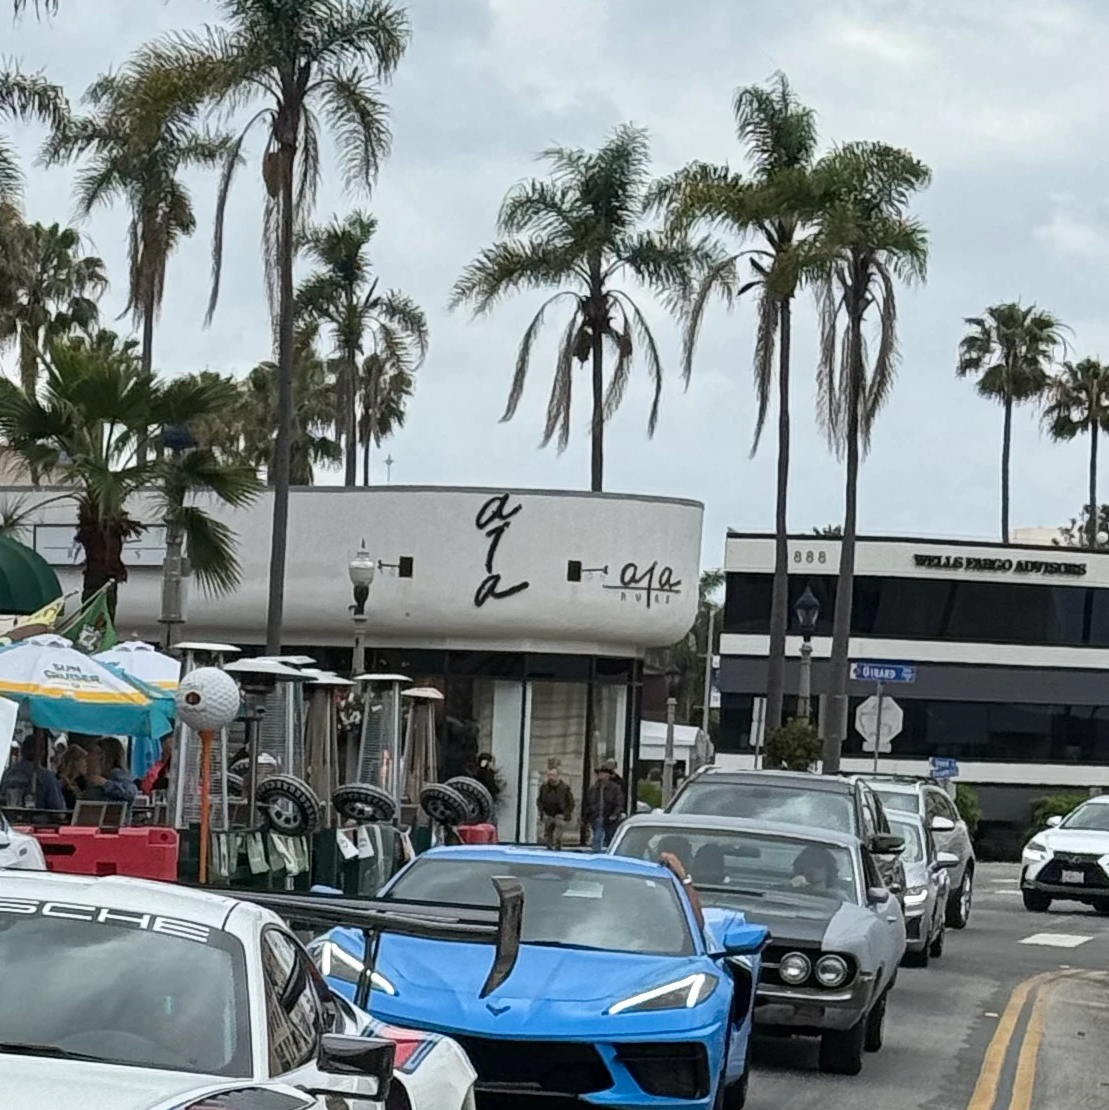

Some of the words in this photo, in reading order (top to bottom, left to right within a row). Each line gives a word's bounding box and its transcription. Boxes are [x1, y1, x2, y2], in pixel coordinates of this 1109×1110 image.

[793, 550, 827, 564] 888
[914, 554, 963, 569] WELLS
[964, 557, 1013, 573] FARGO
[1013, 560, 1088, 577] ADVISORS
